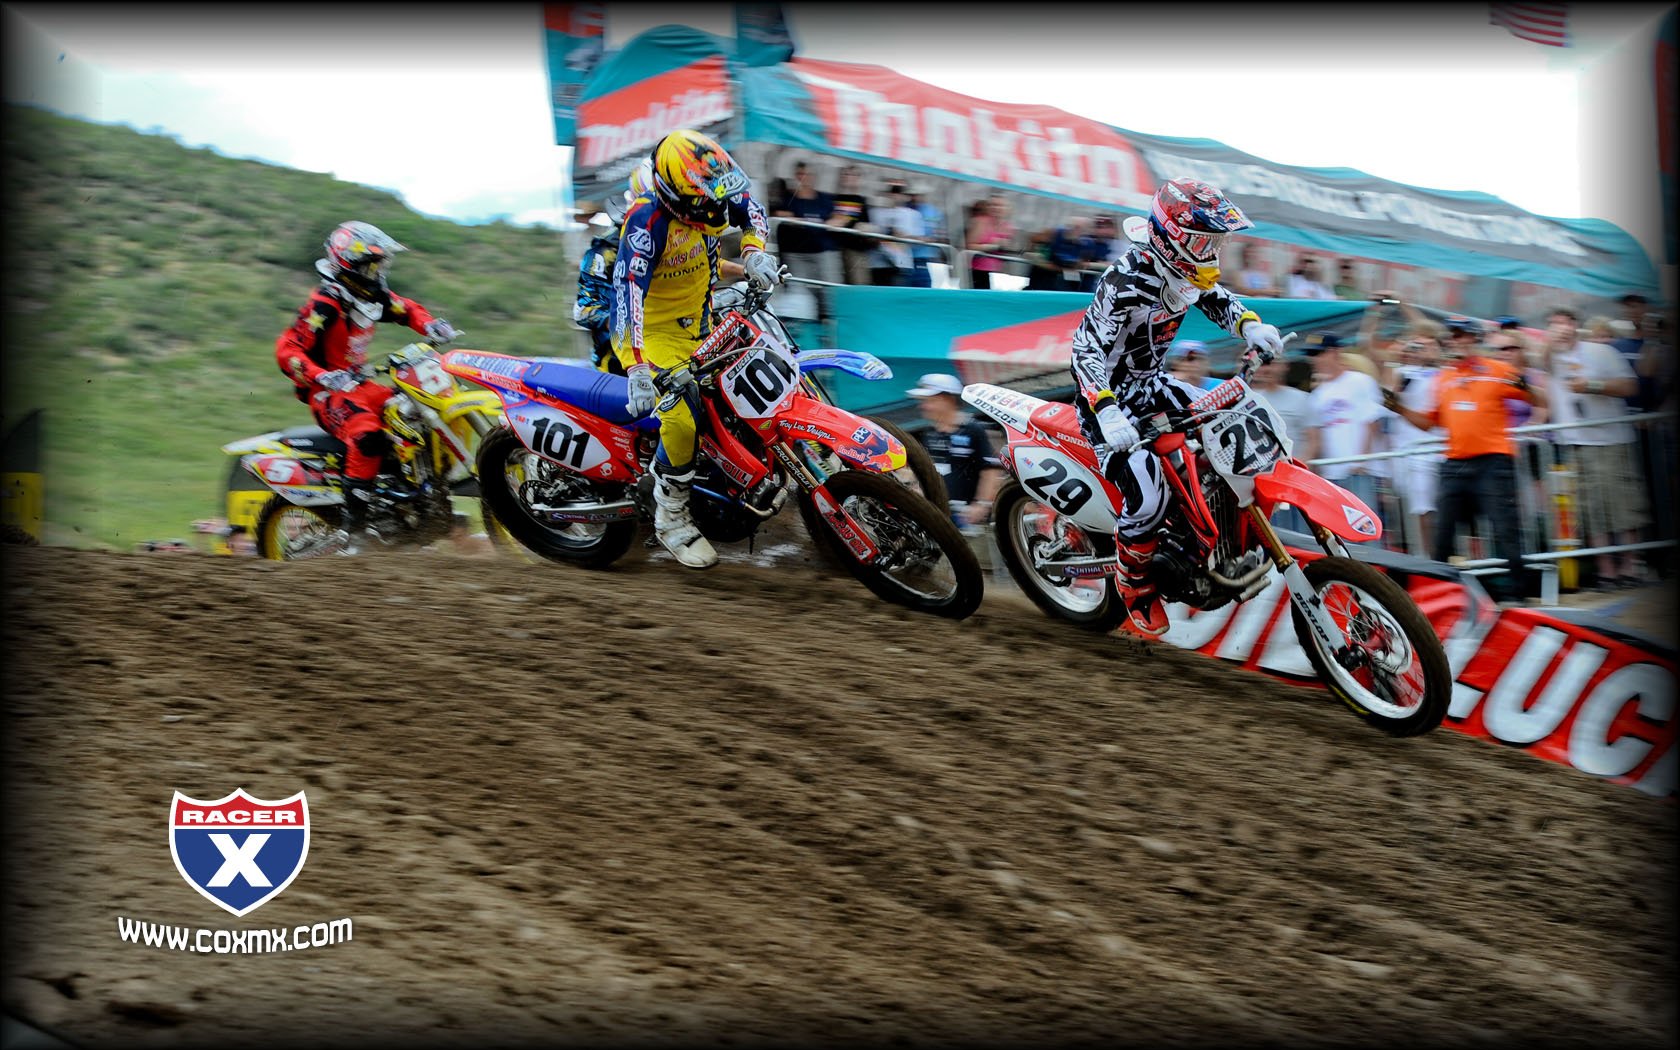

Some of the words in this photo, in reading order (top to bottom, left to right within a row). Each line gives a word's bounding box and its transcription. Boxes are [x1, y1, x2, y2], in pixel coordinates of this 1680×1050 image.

[783, 74, 1148, 207] makita
[663, 261, 705, 279] HONDA
[733, 344, 794, 416] 101
[779, 420, 792, 431] Troy
[794, 421, 805, 431] Lee
[973, 398, 1018, 424] DUNLOP
[531, 417, 591, 469] 101
[1056, 432, 1093, 450] HONDA
[1220, 408, 1276, 475] 29
[264, 459, 300, 483] 5
[773, 445, 789, 461] PRO
[787, 459, 814, 489] CIRCUIT
[1024, 458, 1093, 517] 29
[1293, 591, 1330, 642] DUNLOP
